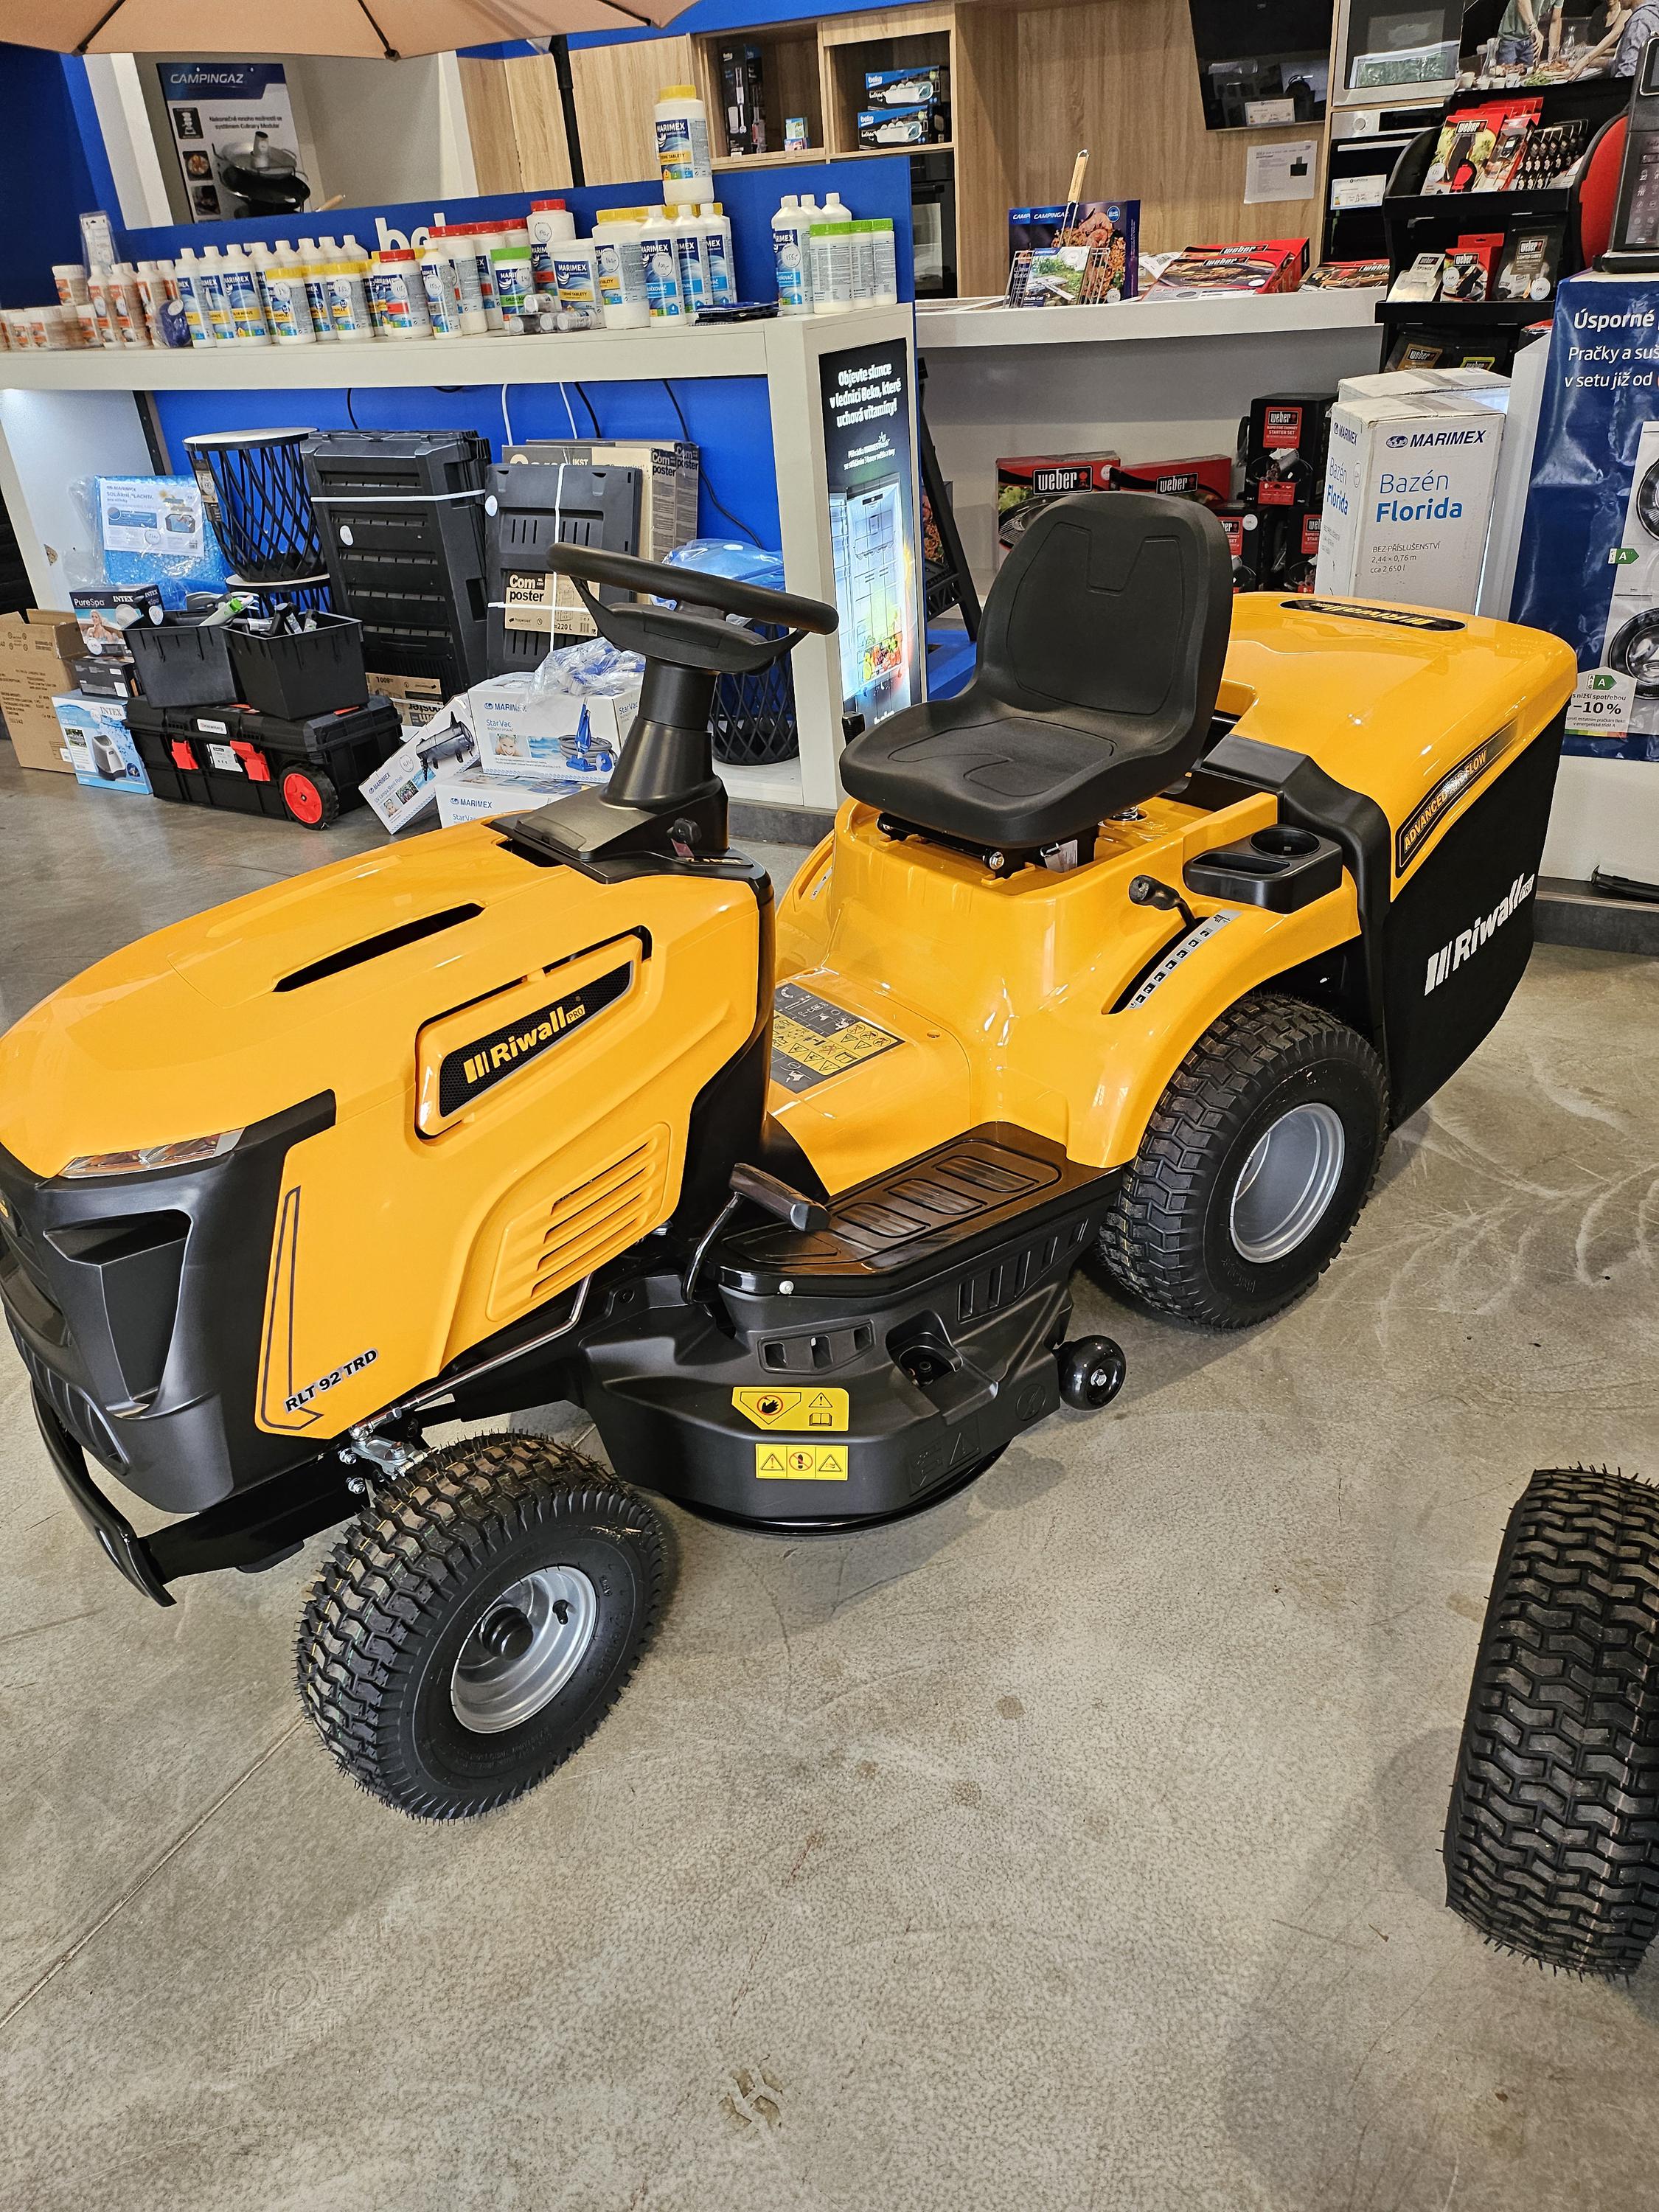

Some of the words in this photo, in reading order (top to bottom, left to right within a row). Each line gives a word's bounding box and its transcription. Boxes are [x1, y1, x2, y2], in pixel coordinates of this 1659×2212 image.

[170, 74, 243, 83] CAMPINGAZ
[1458, 122, 1481, 133] weber
[1223, 246, 1256, 254] weber
[1520, 240, 1537, 252] weber
[1206, 257, 1239, 265] weber
[1456, 254, 1472, 265] weber
[558, 264, 587, 272] MARIMEX
[1573, 307, 1655, 333] Úsporné
[1409, 349, 1429, 360] weber
[1568, 345, 1620, 364] Pračky
[1621, 348, 1631, 360] a
[838, 368, 868, 389] Objevte
[868, 363, 892, 380] slunce
[1565, 377, 1573, 388] v
[1576, 374, 1610, 388] setu
[1610, 372, 1631, 391] již
[1632, 371, 1653, 386] od
[830, 396, 835, 408] v
[835, 387, 861, 408] lednici
[861, 384, 882, 401] Beko,
[882, 378, 902, 396] které
[836, 407, 864, 428] uchová
[863, 397, 898, 420] vitamíny!
[1270, 411, 1291, 423] weber
[1339, 425, 1358, 446] MARIMEX
[1410, 430, 1486, 448] MARIMEX
[652, 451, 671, 465] Com
[675, 446, 693, 458] Com
[652, 465, 676, 476] poster
[676, 458, 699, 471] poster
[1329, 457, 1347, 485] Bazén
[1038, 469, 1077, 491] weber
[1160, 476, 1187, 493] weber
[1380, 470, 1449, 494] Bazén
[1327, 484, 1349, 516] Florida
[1376, 496, 1463, 523] Florida
[1388, 541, 1441, 553] PŘÍSLUŠENSTVÍ
[1371, 556, 1386, 564] 2,44
[1394, 554, 1408, 563] 0,76
[509, 574, 536, 589] Com
[145, 589, 159, 598] INTEX
[509, 590, 544, 602] poster
[74, 598, 105, 608] PureSpa
[100, 706, 123, 717] INTEX
[619, 705, 628, 714] Star
[628, 701, 638, 712] Vac
[1607, 703, 1621, 714] %
[486, 719, 499, 727] Star
[499, 720, 512, 728] Vac
[372, 771, 391, 790] MARIMEX
[460, 799, 493, 809] MARIMEX
[1404, 790, 1448, 852] ADVANCED
[1464, 748, 1487, 776] FLOW
[453, 813, 465, 821] Star
[1453, 872, 1525, 972] Riwall
[490, 1006, 566, 1068] Riwall
[567, 1007, 584, 1021] PRO
[285, 1385, 315, 1412] RLT
[319, 1371, 341, 1391] 92
[343, 1349, 377, 1376] TRD
